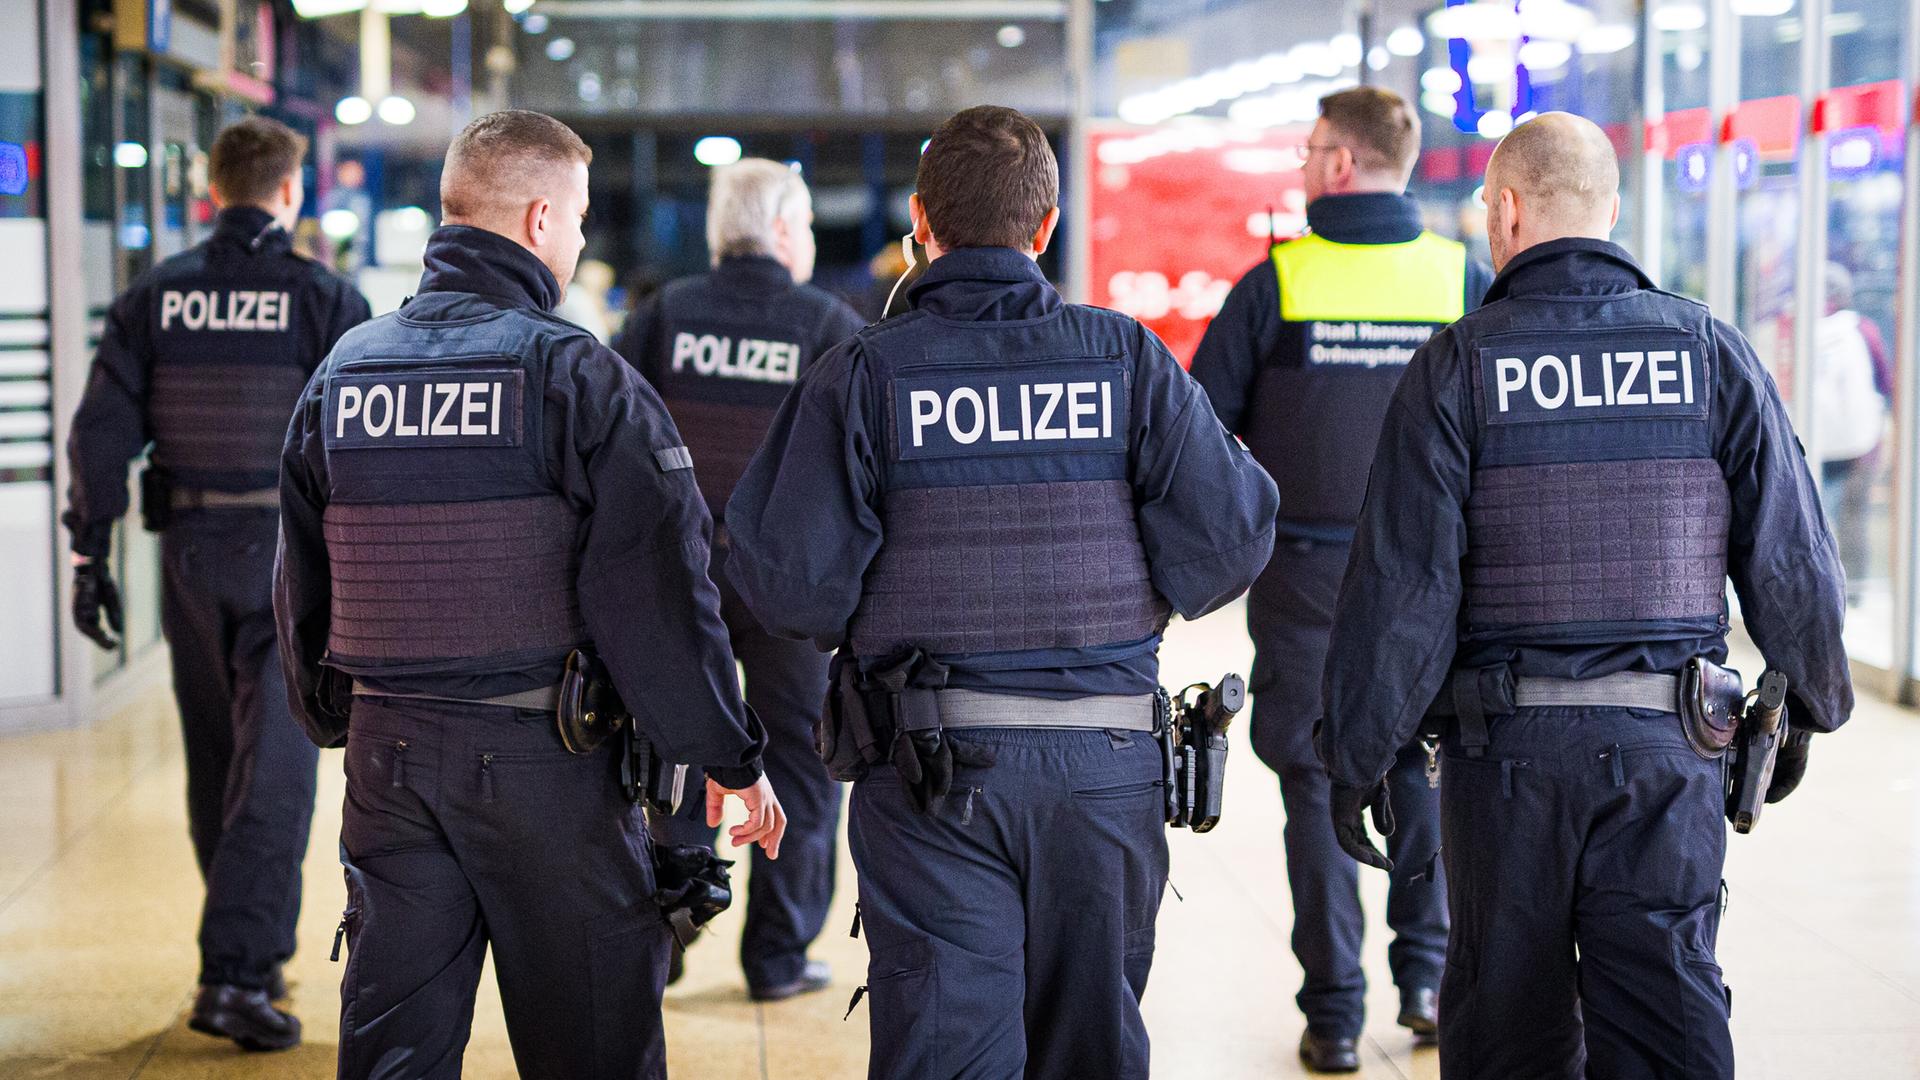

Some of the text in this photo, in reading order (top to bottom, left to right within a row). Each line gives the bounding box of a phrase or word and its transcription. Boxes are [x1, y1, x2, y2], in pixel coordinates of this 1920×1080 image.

[161, 290, 290, 331] POLIZEI
[1312, 321, 1433, 342] Stadt Hannover
[672, 332, 800, 382] POLIZEI
[1496, 350, 1694, 412] POLIZEI
[336, 382, 502, 438] POLIZEI
[910, 381, 1112, 447] POLIZEI
